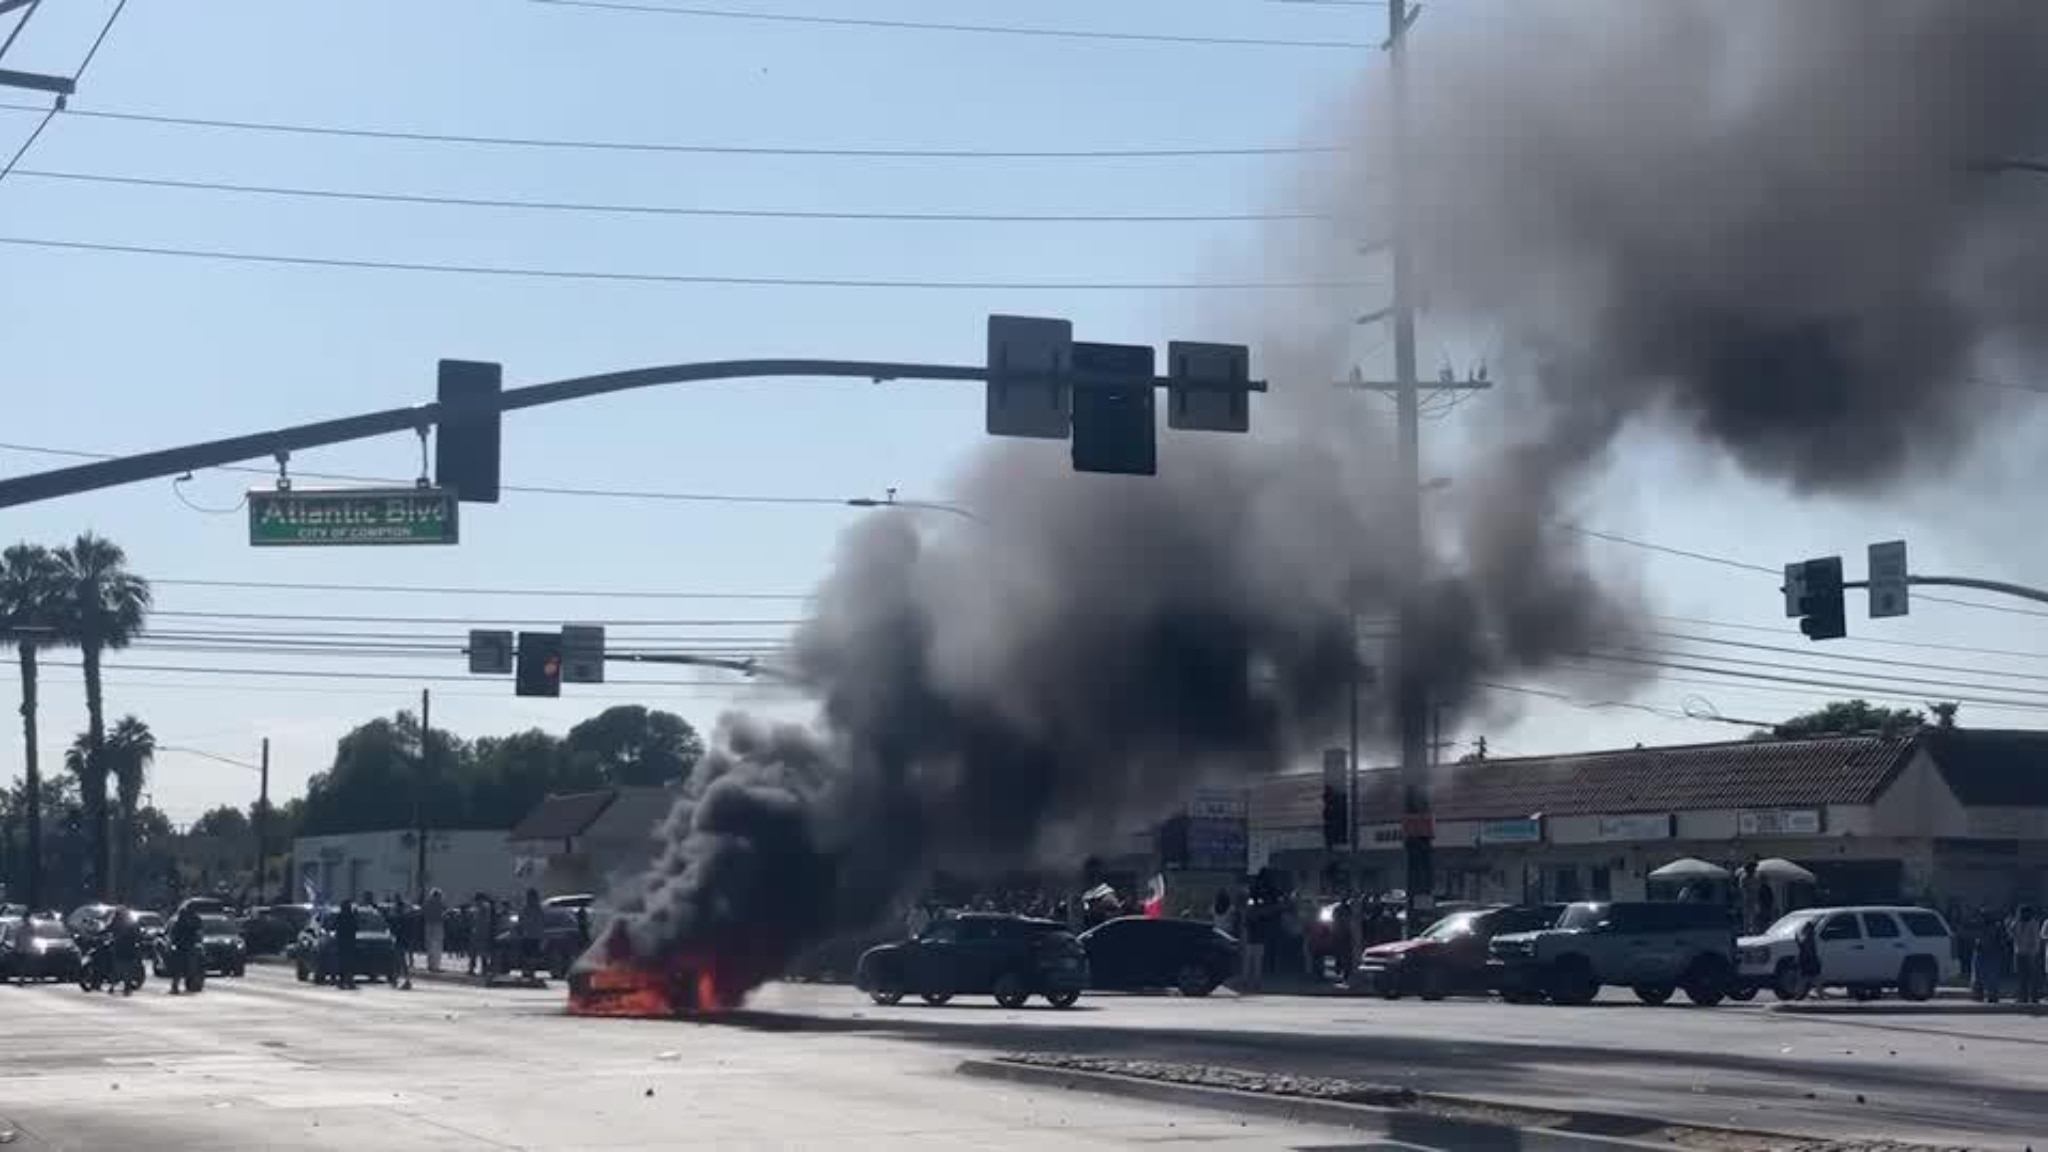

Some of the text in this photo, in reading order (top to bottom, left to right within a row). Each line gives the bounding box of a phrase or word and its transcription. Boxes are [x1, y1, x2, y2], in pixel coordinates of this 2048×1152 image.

[261, 498, 448, 525] Atlantic Blvd
[298, 527, 412, 538] CITY OF COMPTON
